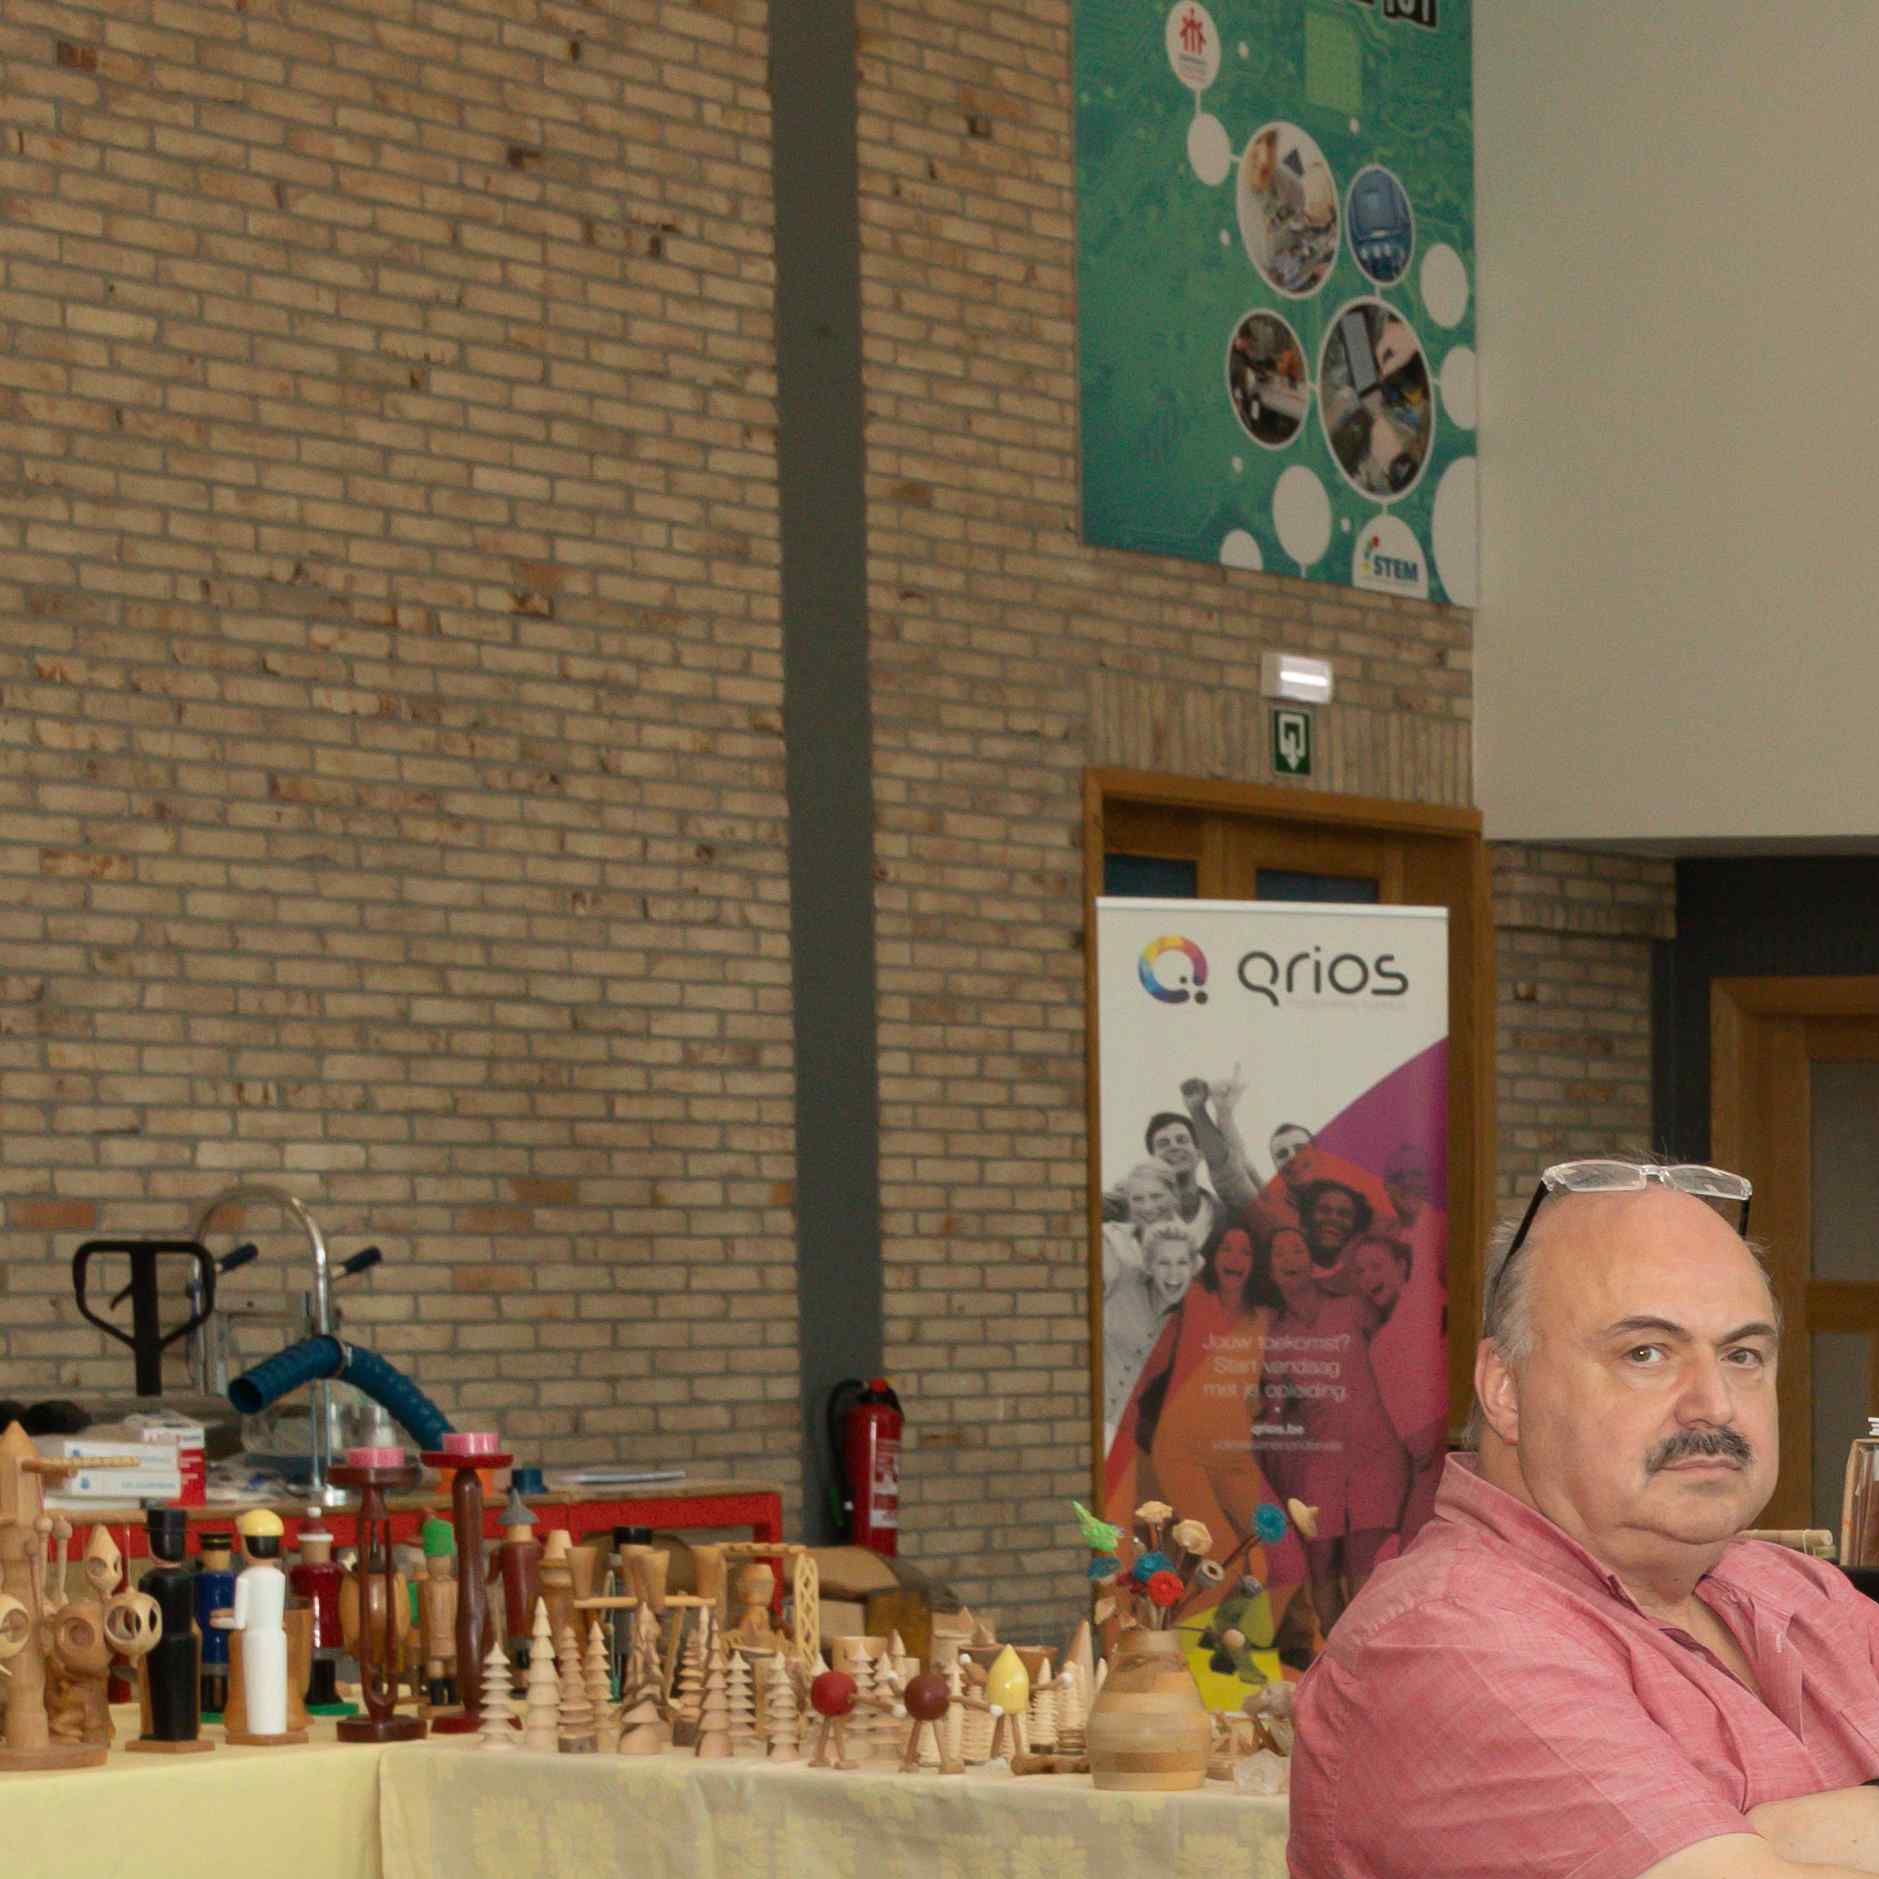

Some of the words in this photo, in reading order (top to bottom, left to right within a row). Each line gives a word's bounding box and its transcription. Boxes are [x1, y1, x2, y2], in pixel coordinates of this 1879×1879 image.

[1373, 555, 1419, 582] STEM
[1201, 1333, 1249, 1350] Jouw
[1256, 1333, 1351, 1352] toekomst?
[1214, 1356, 1258, 1374] Start
[1264, 1359, 1341, 1378] vandaag
[1202, 1383, 1238, 1394] met
